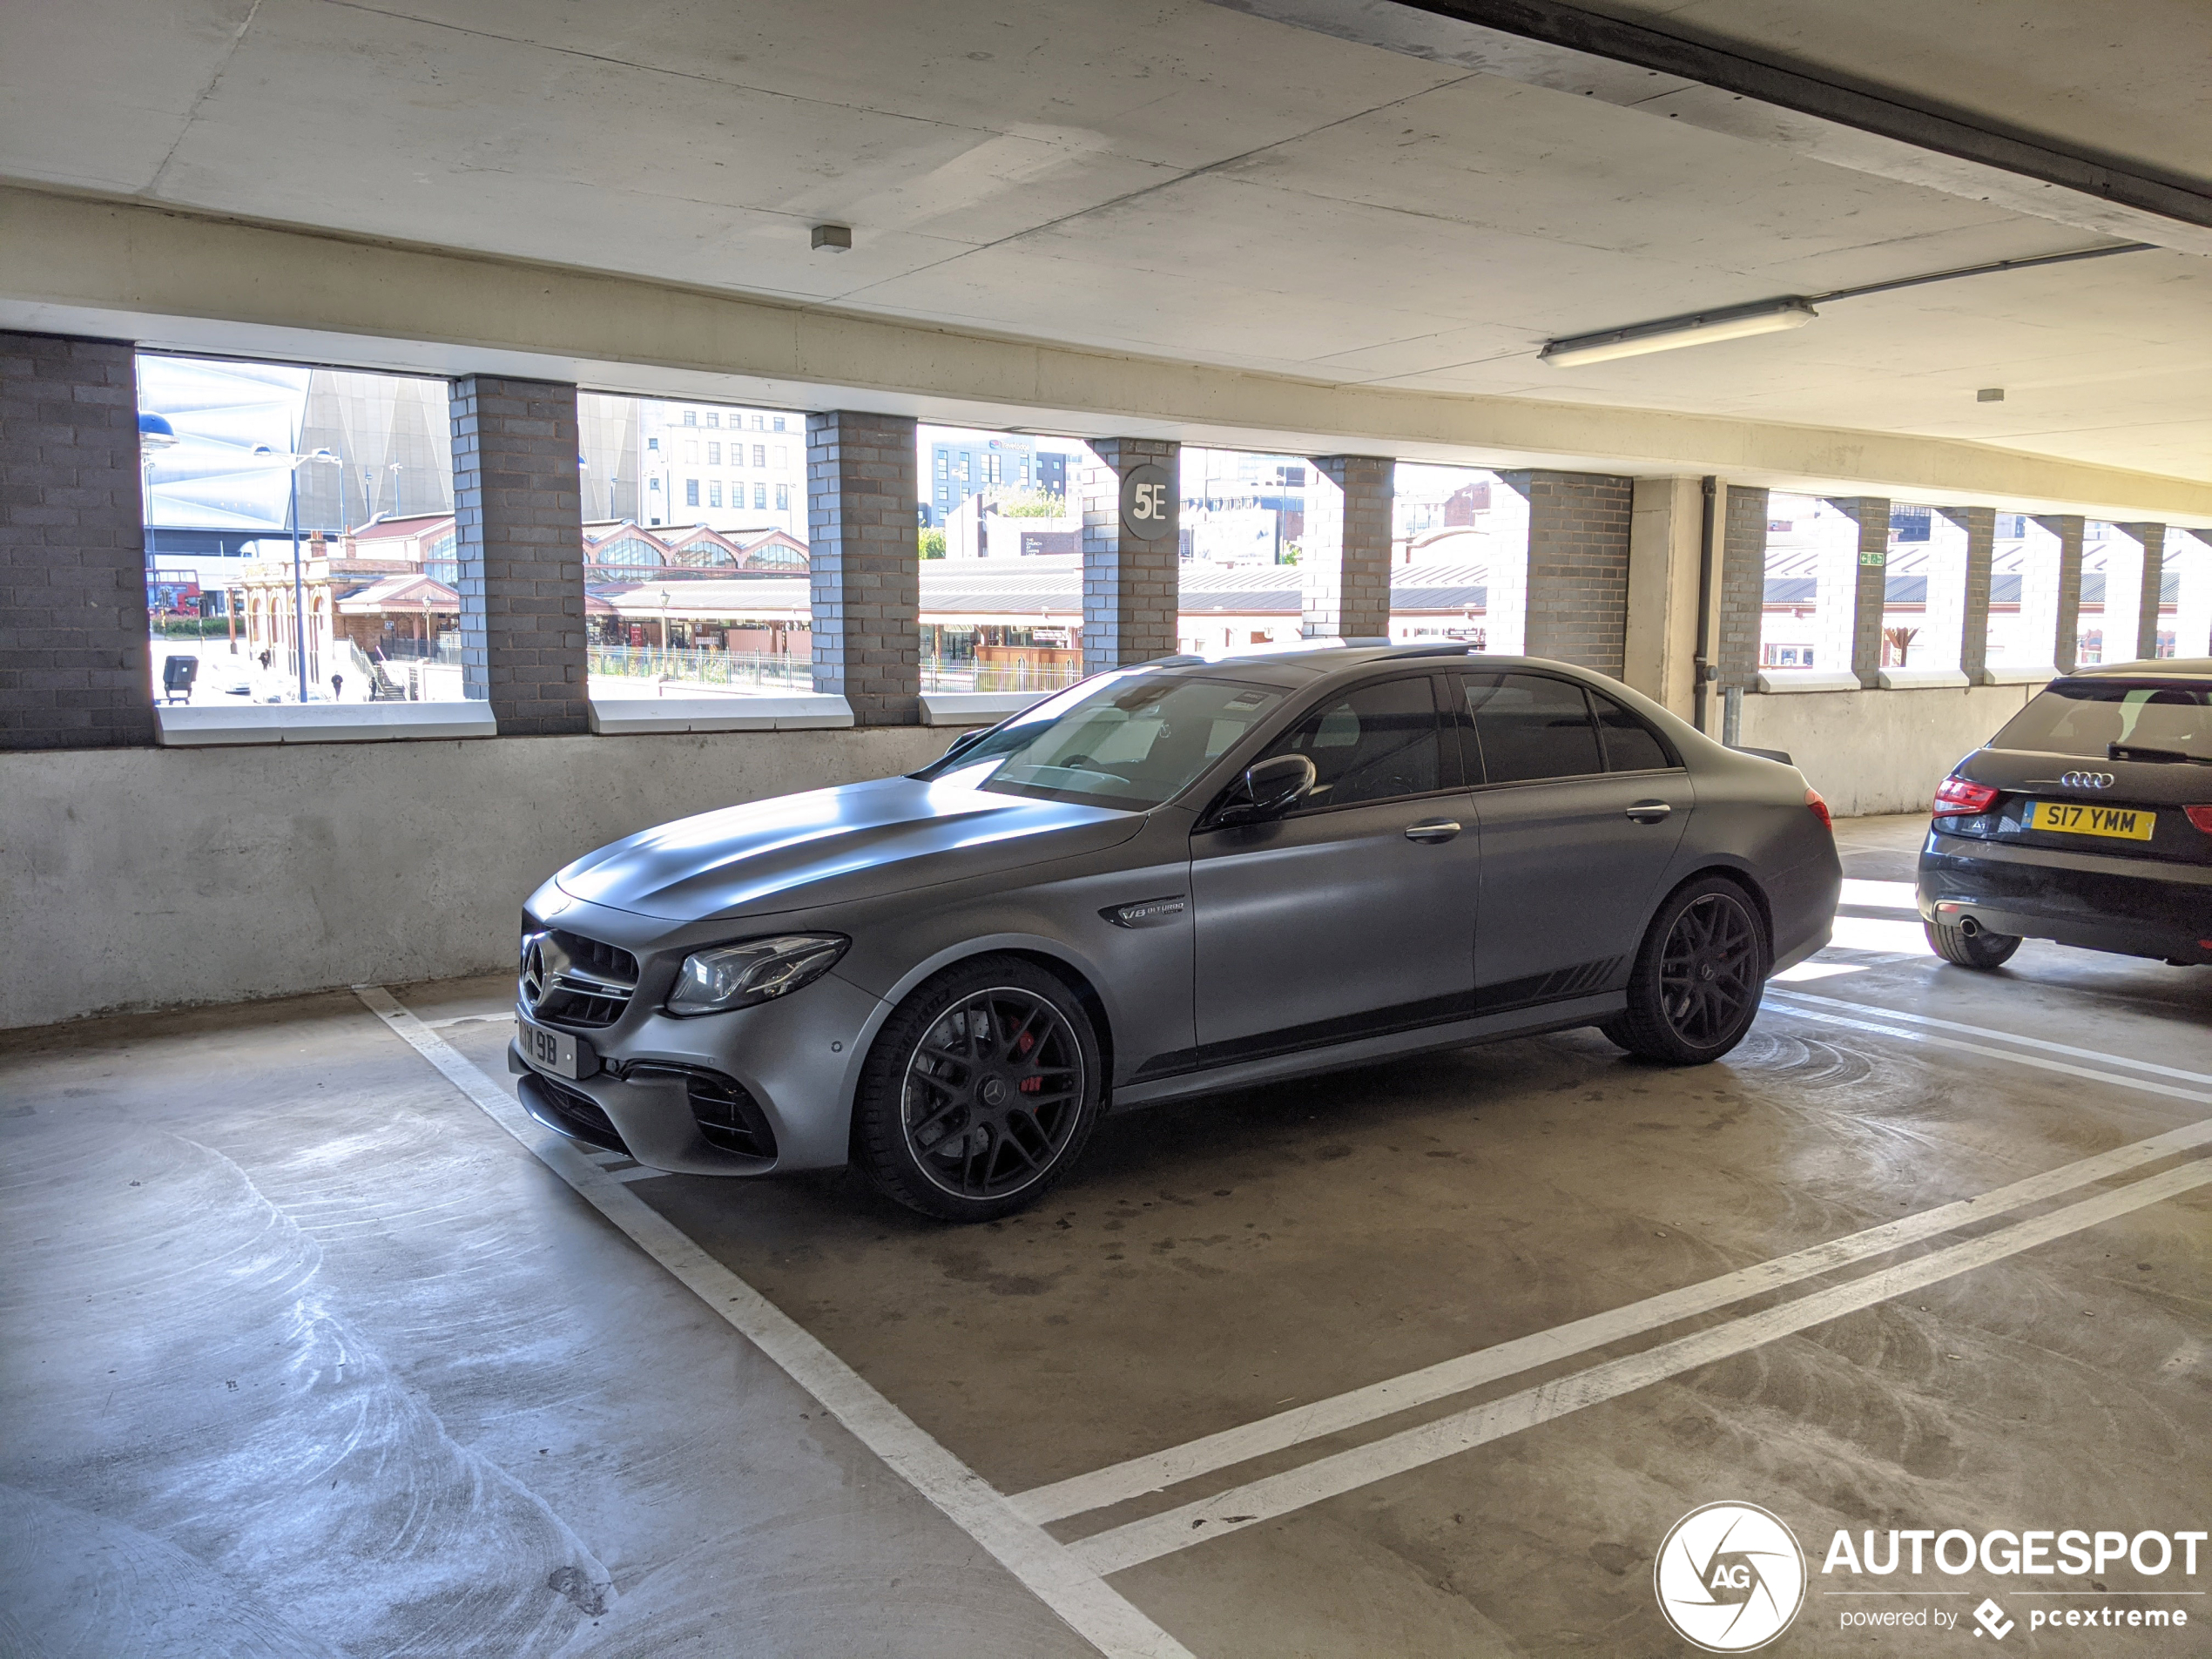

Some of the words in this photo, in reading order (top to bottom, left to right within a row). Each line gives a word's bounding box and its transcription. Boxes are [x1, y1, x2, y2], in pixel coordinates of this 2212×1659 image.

[1133, 483, 1166, 520] 5E
[2047, 806, 2083, 826] S17
[2091, 809, 2137, 833] YMM
[1123, 909, 1146, 919] V8
